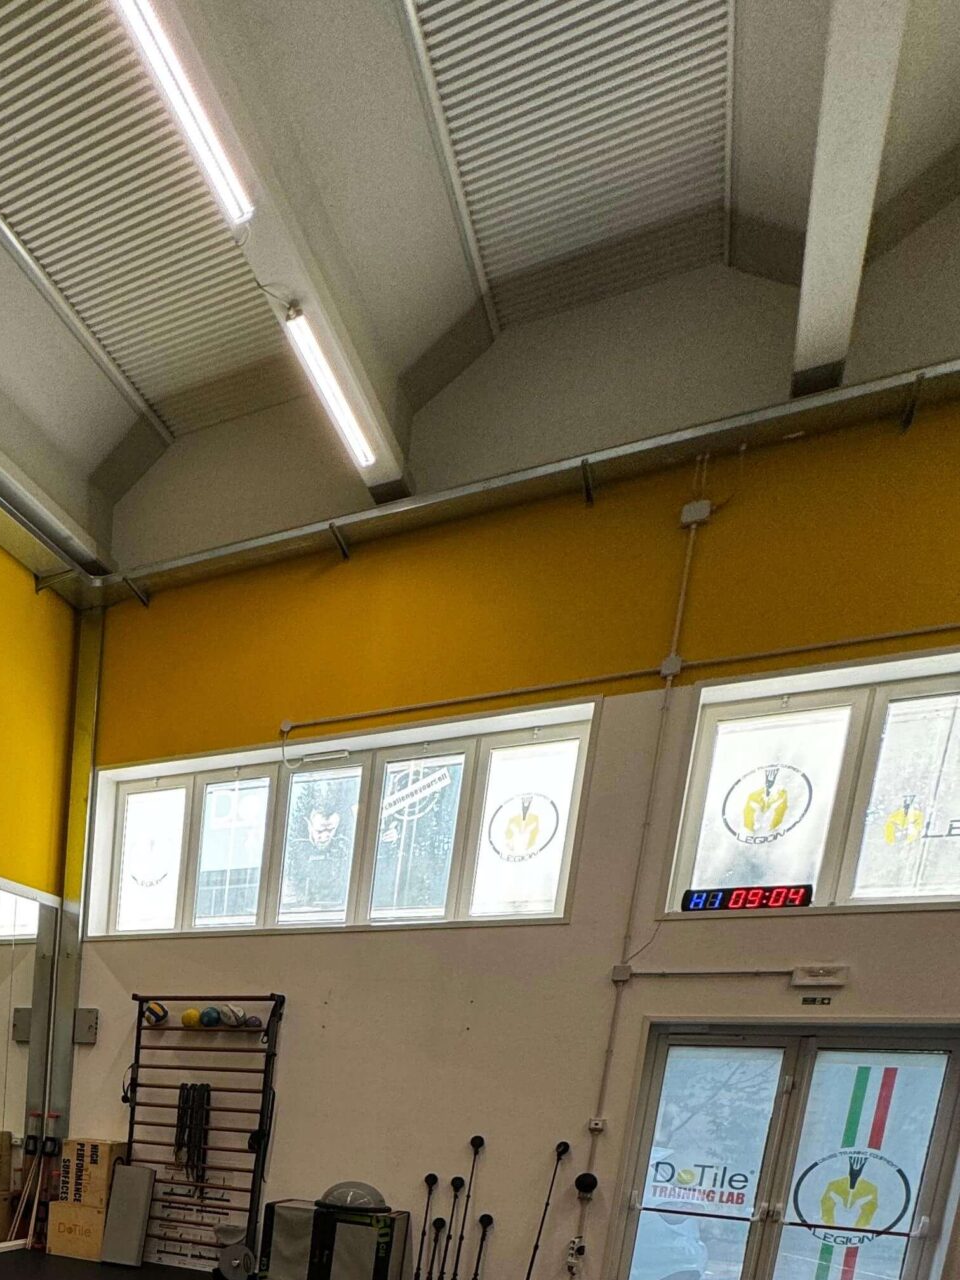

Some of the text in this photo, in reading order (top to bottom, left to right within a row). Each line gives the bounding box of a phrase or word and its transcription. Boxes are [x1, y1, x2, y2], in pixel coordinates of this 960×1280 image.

[728, 888, 805, 908] 09:04
[90, 1144, 99, 1165] HIGH
[60, 1158, 71, 1201] SURFACES
[73, 1142, 85, 1203] PERFORMANCE
[652, 1185, 745, 1205] TRAINING LAB
[811, 1224, 875, 1245] LEGION
